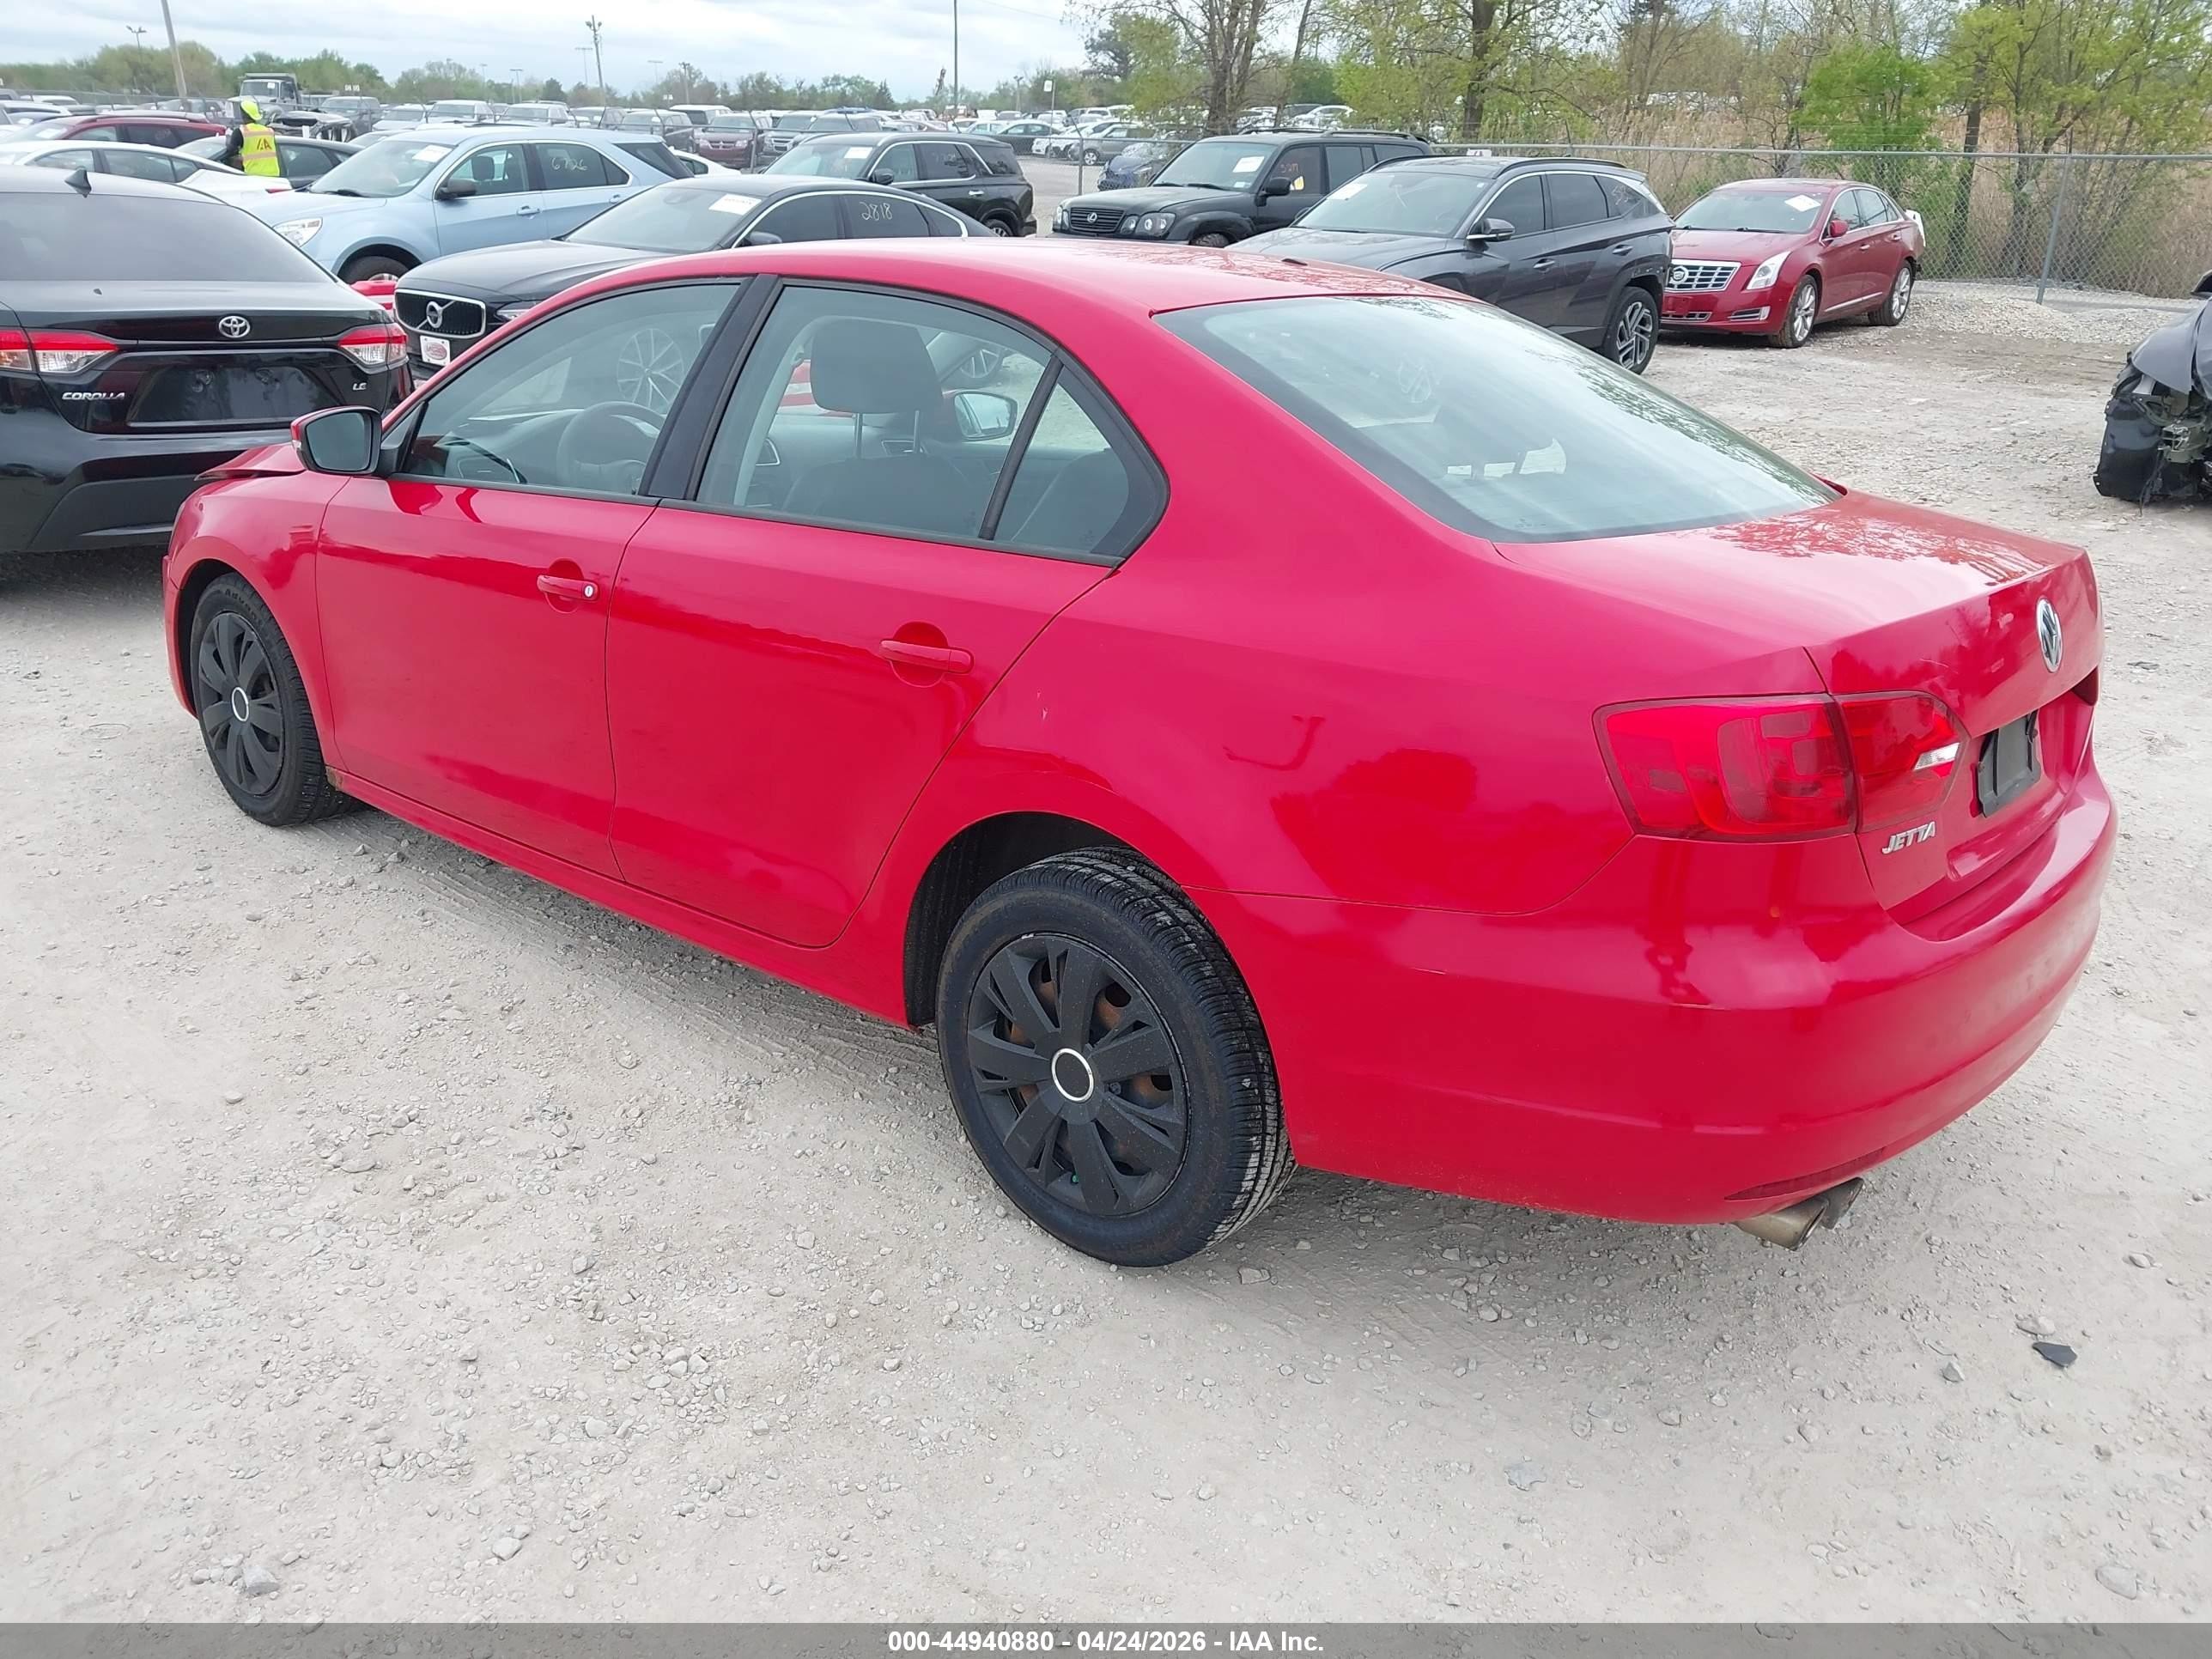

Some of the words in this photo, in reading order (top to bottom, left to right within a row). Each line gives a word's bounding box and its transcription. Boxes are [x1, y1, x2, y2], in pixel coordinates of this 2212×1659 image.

[859, 201, 893, 222] 2818
[352, 382, 367, 391] LE
[62, 392, 125, 401] COROLLA
[1881, 821, 1936, 854] JETTA
